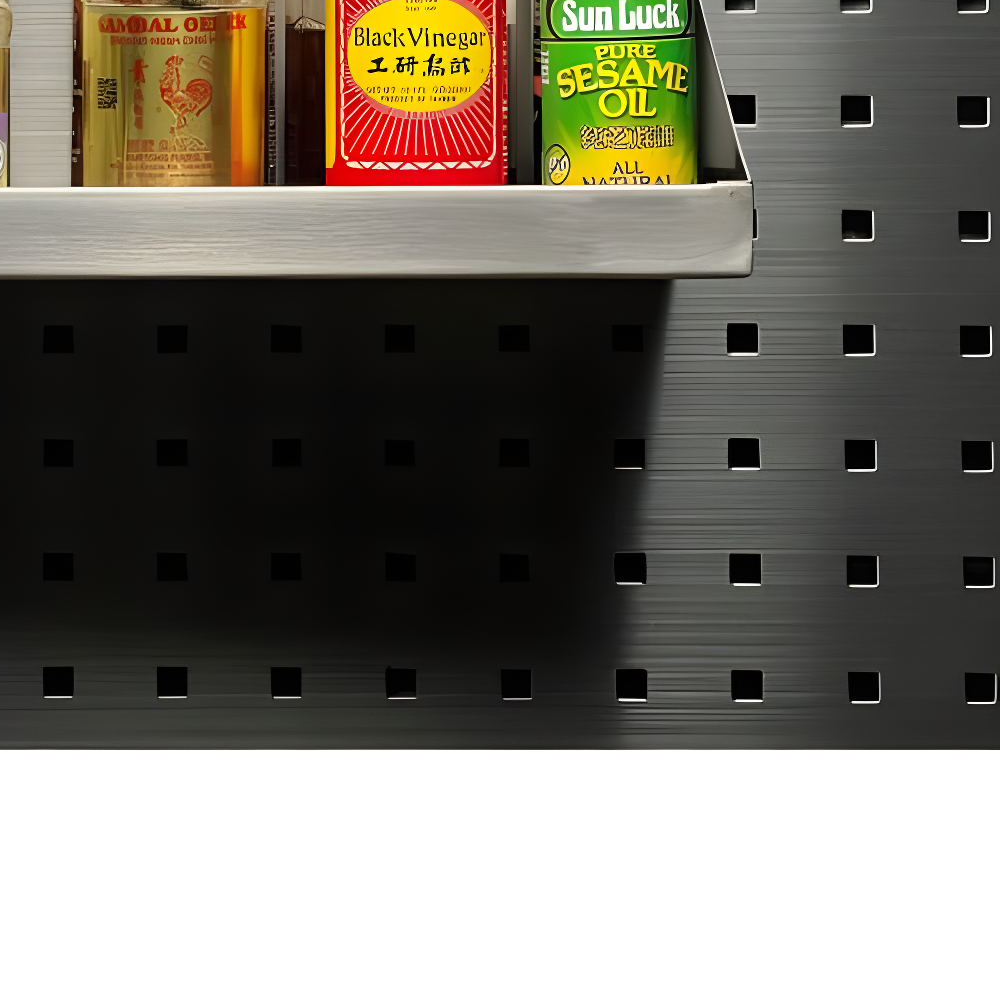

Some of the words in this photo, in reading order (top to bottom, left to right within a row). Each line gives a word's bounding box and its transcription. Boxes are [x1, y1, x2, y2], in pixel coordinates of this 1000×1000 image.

[562, 0, 613, 32] Sun
[354, 26, 406, 48] Black
[407, 26, 487, 50] Vinegar
[594, 43, 657, 61] PURE
[557, 58, 689, 99] SESAME
[598, 87, 657, 118] OIL
[612, 161, 644, 175] ALL
